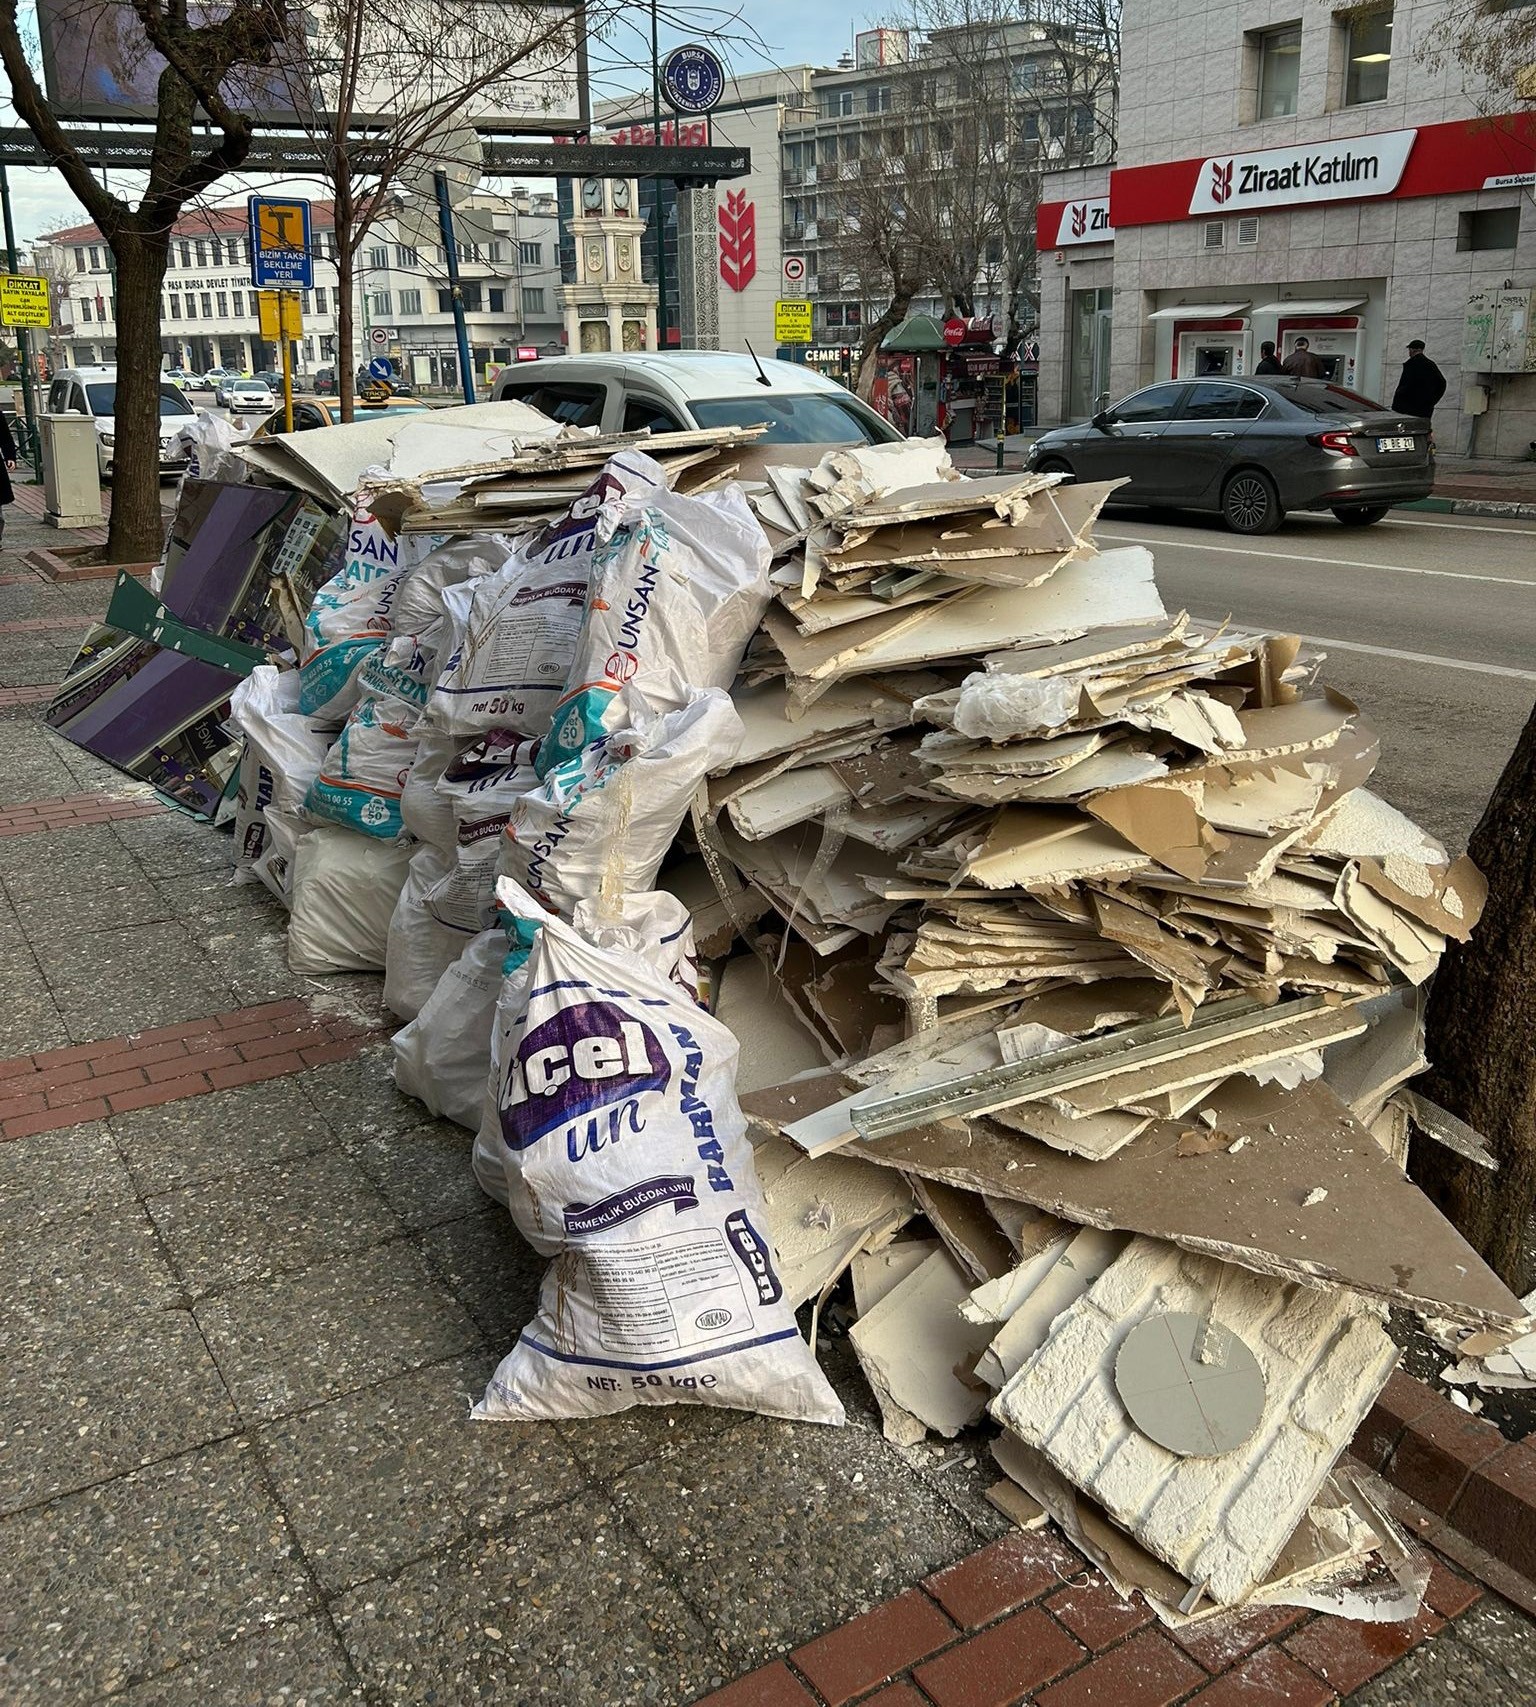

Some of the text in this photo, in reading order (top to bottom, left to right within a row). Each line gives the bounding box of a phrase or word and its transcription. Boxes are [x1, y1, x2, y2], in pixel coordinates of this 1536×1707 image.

[681, 51, 705, 61] BURSA
[1238, 152, 1379, 195] Ziraat Katılım
[1091, 208, 1110, 231] Zir
[264, 261, 303, 270] BEKLEME
[274, 270, 293, 279] YERİ
[8, 280, 39, 290] DİKKAT
[184, 279, 204, 290] BURSA
[206, 278, 228, 289] DEVLET
[231, 276, 251, 287] TİYATR
[805, 350, 840, 361] CEMRE
[618, 564, 660, 649] UNSAN
[472, 698, 525, 714] net 50 kg
[562, 727, 577, 740] 50
[342, 797, 353, 806] 55
[367, 811, 383, 821] 50
[526, 813, 576, 890] UNSAN
[667, 1022, 734, 1192] HARMAN
[566, 1098, 646, 1163] un
[567, 1181, 693, 1232] EKMEKLİK BUĞDAY UNU
[586, 1376, 622, 1392] NET:
[632, 1373, 658, 1388] 50
